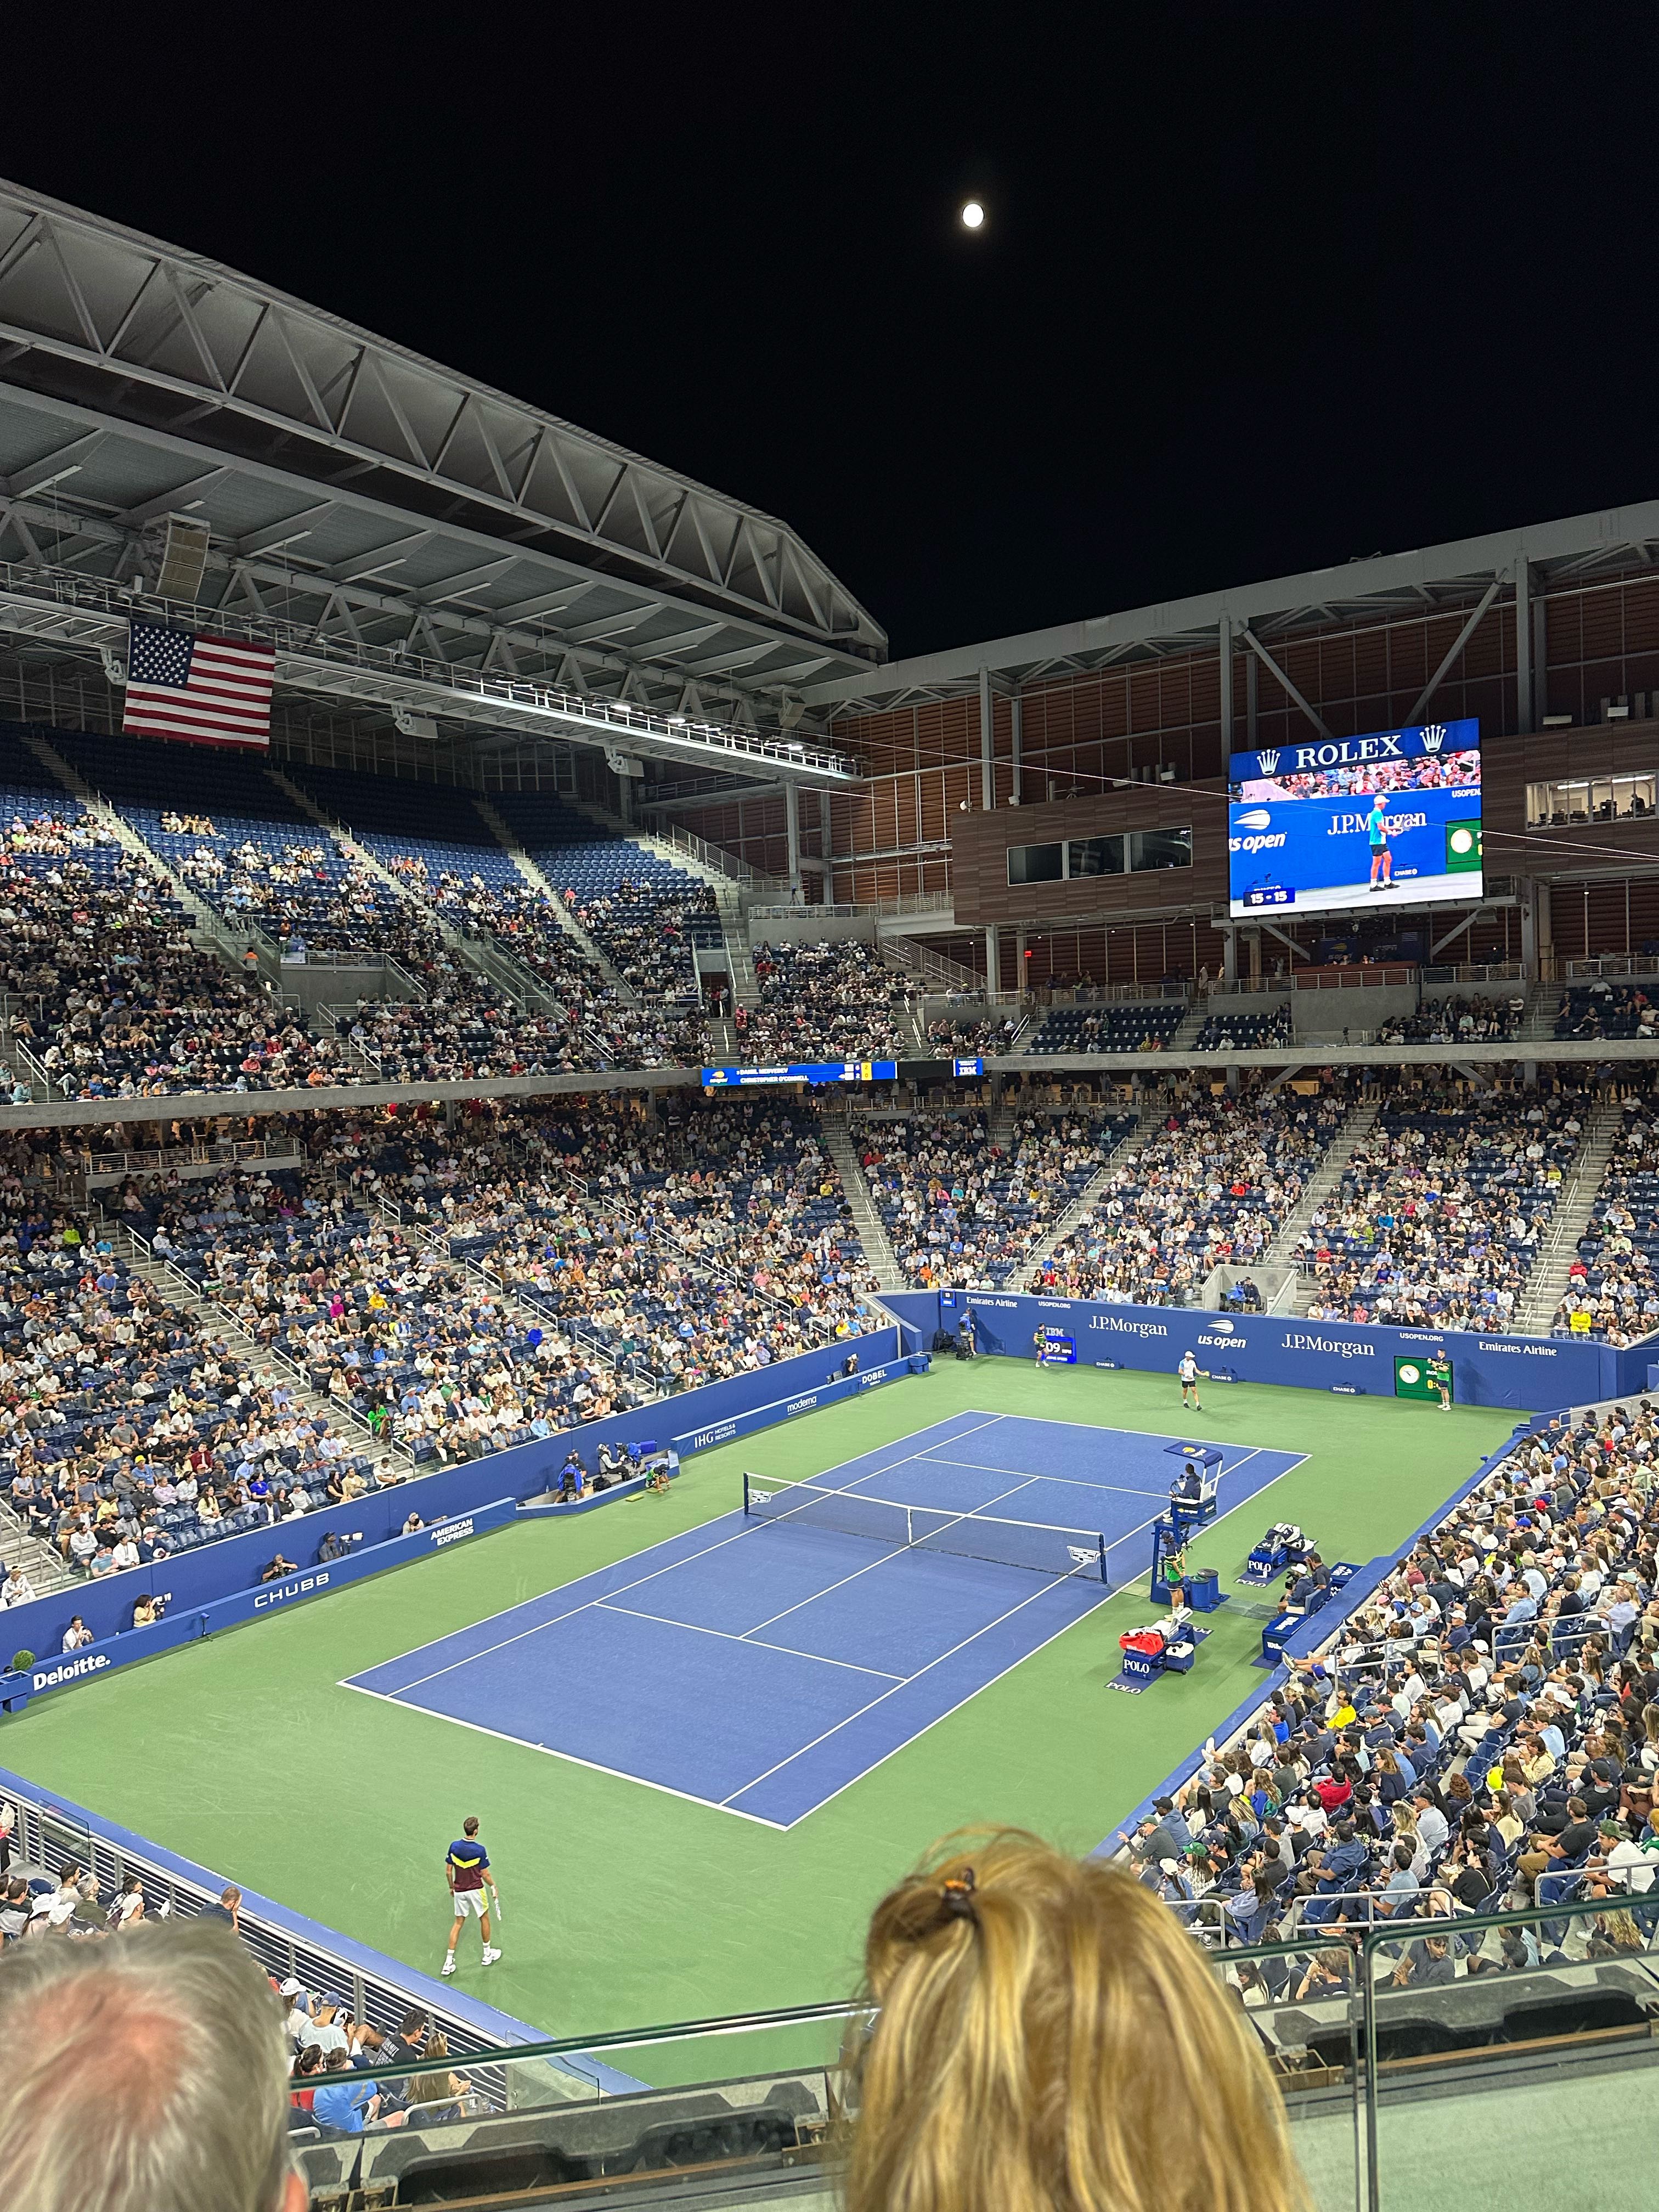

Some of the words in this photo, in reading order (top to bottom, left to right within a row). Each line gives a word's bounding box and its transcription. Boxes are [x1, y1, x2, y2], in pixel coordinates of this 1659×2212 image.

[1296, 735, 1403, 769] ROLEX
[1327, 812, 1427, 835] J.P.Mrgan
[1243, 833, 1285, 854] open
[1251, 893, 1264, 904] 15
[1274, 890, 1287, 902] 15
[959, 1066, 977, 1075] IBM
[967, 1296, 994, 1306] Emirates
[995, 1299, 1018, 1308] Airline
[1046, 1327, 1065, 1337] IBM
[1088, 1316, 1168, 1338] J.P.Morgan
[1198, 1335, 1213, 1345] us
[1214, 1337, 1246, 1350] open
[1400, 1332, 1444, 1342] USOPEN.ORG
[1281, 1334, 1375, 1358] J.P.Morgan
[1479, 1341, 1521, 1353] Emirates
[1523, 1345, 1557, 1356] Airline
[862, 1369, 887, 1384] DOBEL
[787, 1396, 817, 1413] moderna
[694, 1431, 713, 1448] IHG
[714, 1424, 732, 1435] HOTELS
[715, 1429, 736, 1441] RESORTS
[430, 1518, 473, 1541] AMERICAN
[437, 1526, 474, 1546] EXPRESS
[1248, 1560, 1272, 1572] POLO
[254, 1572, 329, 1608] CHUBB
[1234, 1578, 1267, 1588] POLO
[33, 1655, 111, 1691] Deloitte.
[1124, 1659, 1150, 1674] POLO
[1105, 1682, 1141, 1694] POLO
